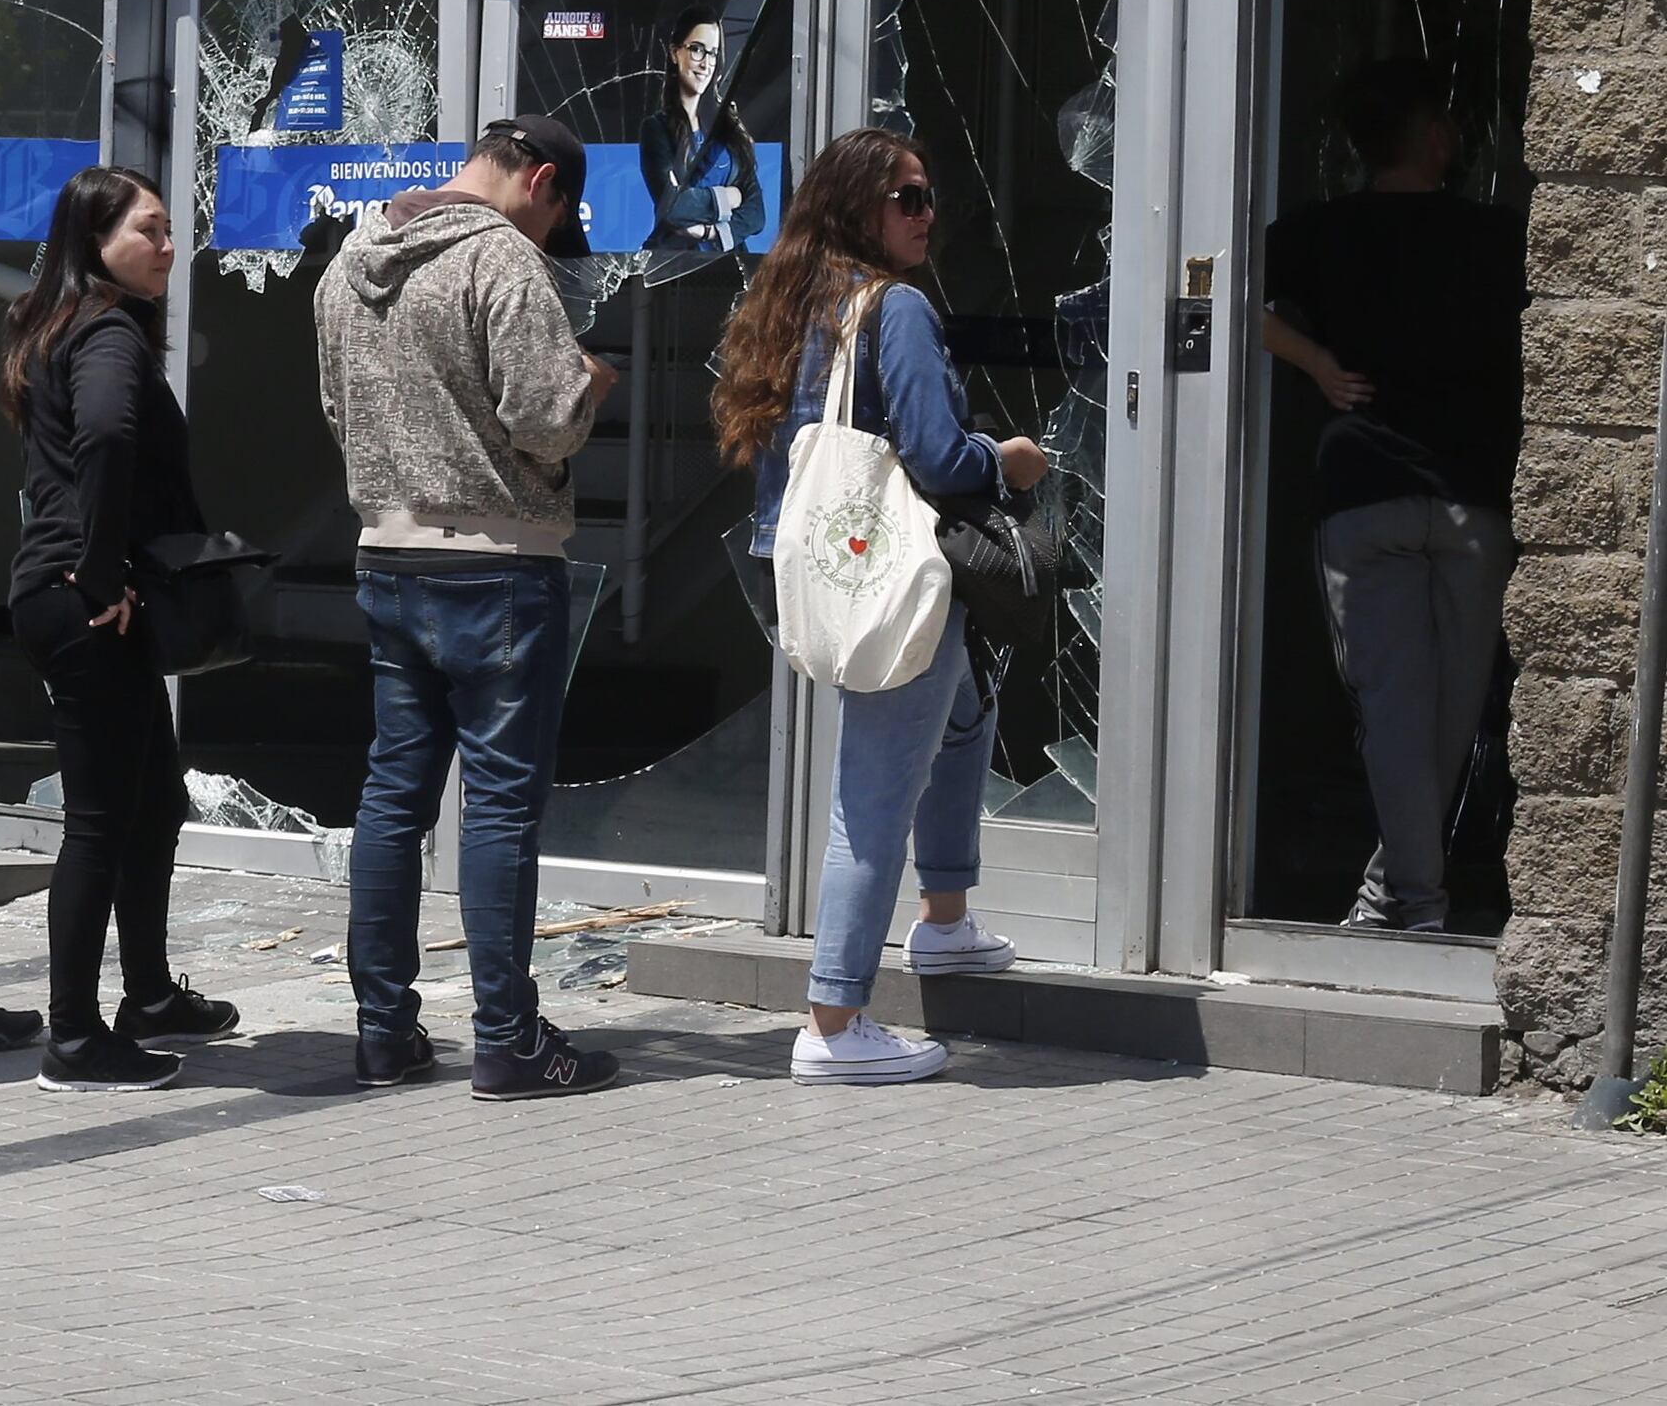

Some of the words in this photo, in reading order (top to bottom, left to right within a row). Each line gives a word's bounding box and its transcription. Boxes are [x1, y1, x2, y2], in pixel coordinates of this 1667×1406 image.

[544, 11, 590, 24] AUNQUE
[330, 158, 432, 180] BIENVENIDOS
[544, 1053, 577, 1085] N
